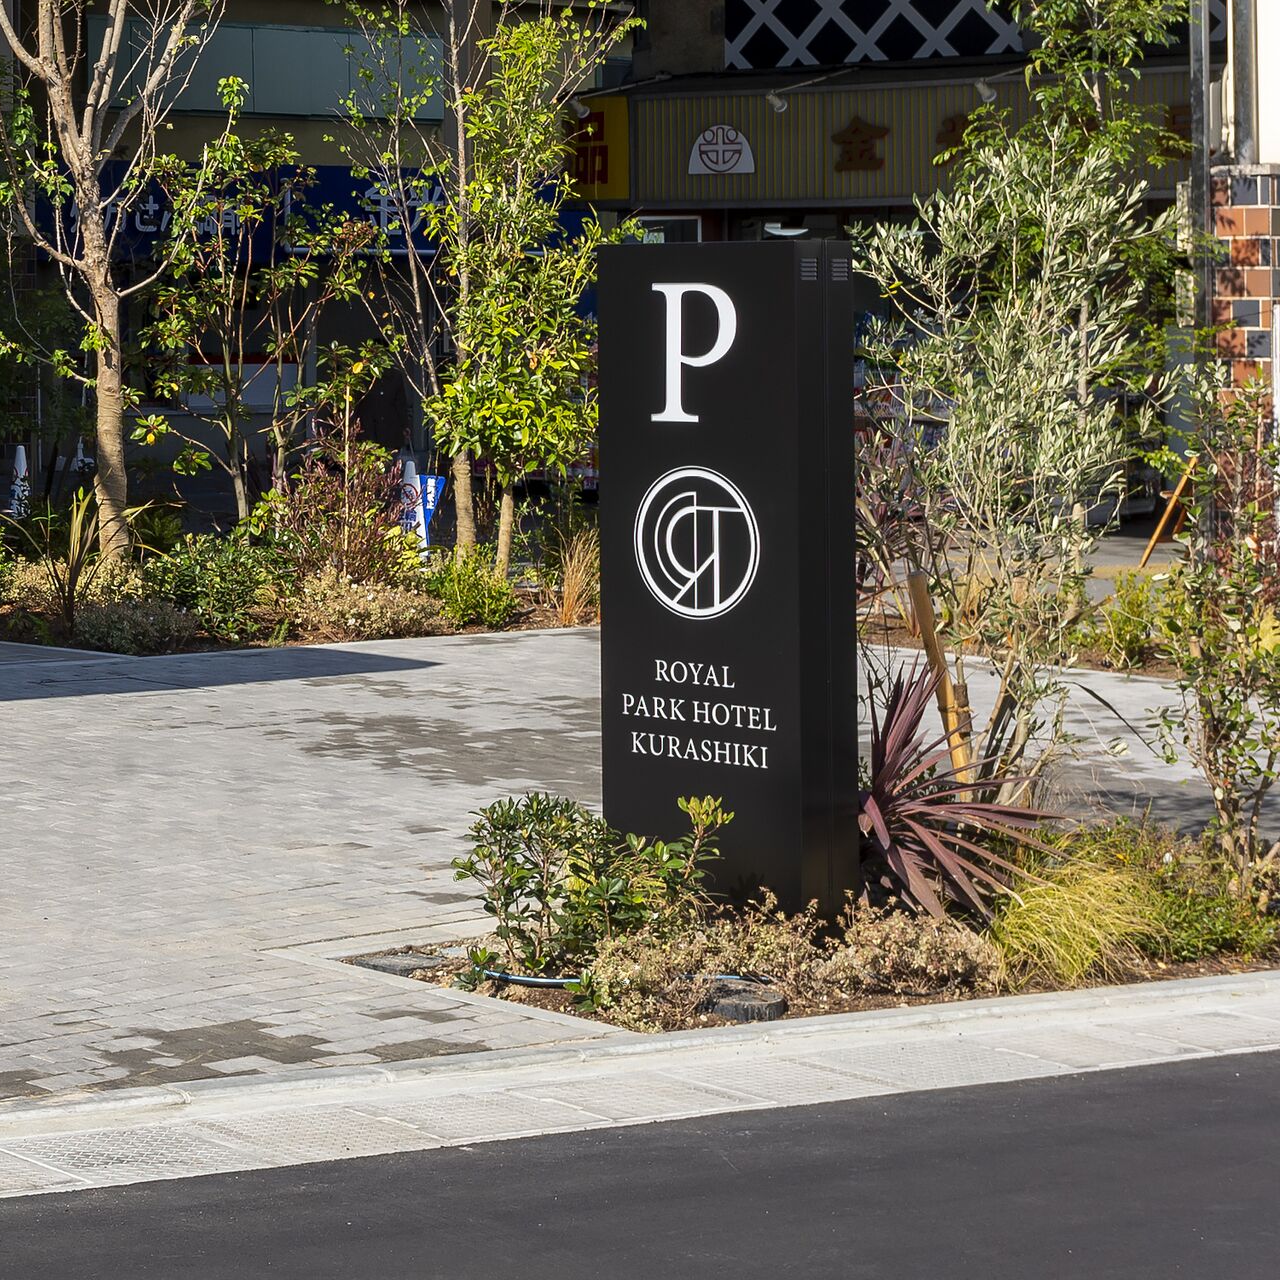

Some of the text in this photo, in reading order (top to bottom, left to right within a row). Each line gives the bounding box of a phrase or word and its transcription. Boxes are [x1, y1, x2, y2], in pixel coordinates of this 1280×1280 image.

[651, 282, 737, 423] P
[654, 660, 736, 688] ROYAL
[622, 694, 777, 731] PARK HOTEL
[631, 733, 769, 769] KURASHIKI
